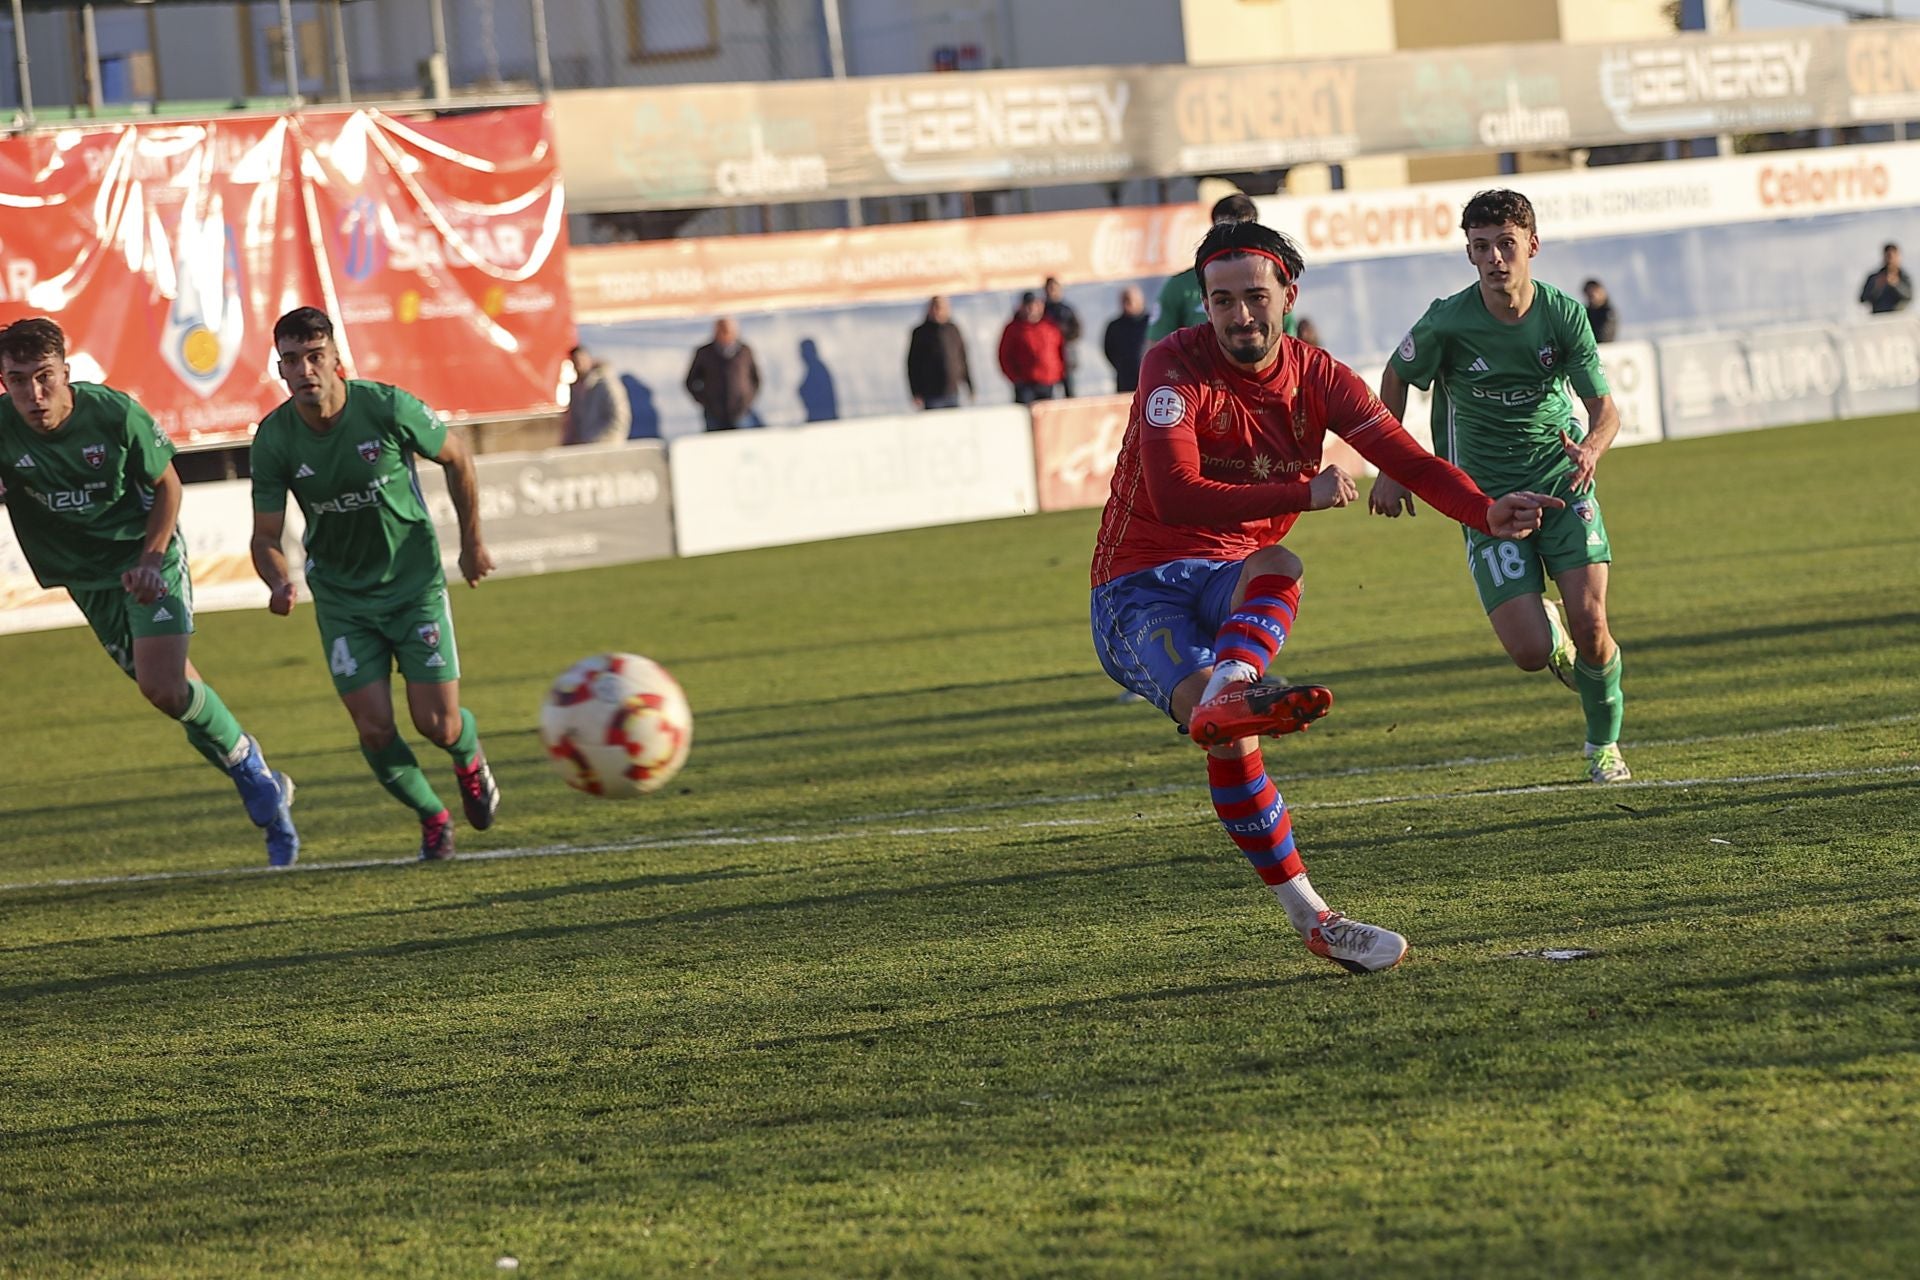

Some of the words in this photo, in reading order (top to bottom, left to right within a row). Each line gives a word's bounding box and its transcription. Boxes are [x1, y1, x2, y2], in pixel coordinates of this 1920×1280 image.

[909, 83, 1130, 152] GENERGY
[1758, 158, 1890, 207] Celorrio
[1304, 194, 1454, 250] Celorrio
[518, 466, 659, 516] Serrano
[1482, 541, 1526, 588] 18
[330, 635, 358, 679] 4
[1150, 627, 1184, 666] 7
